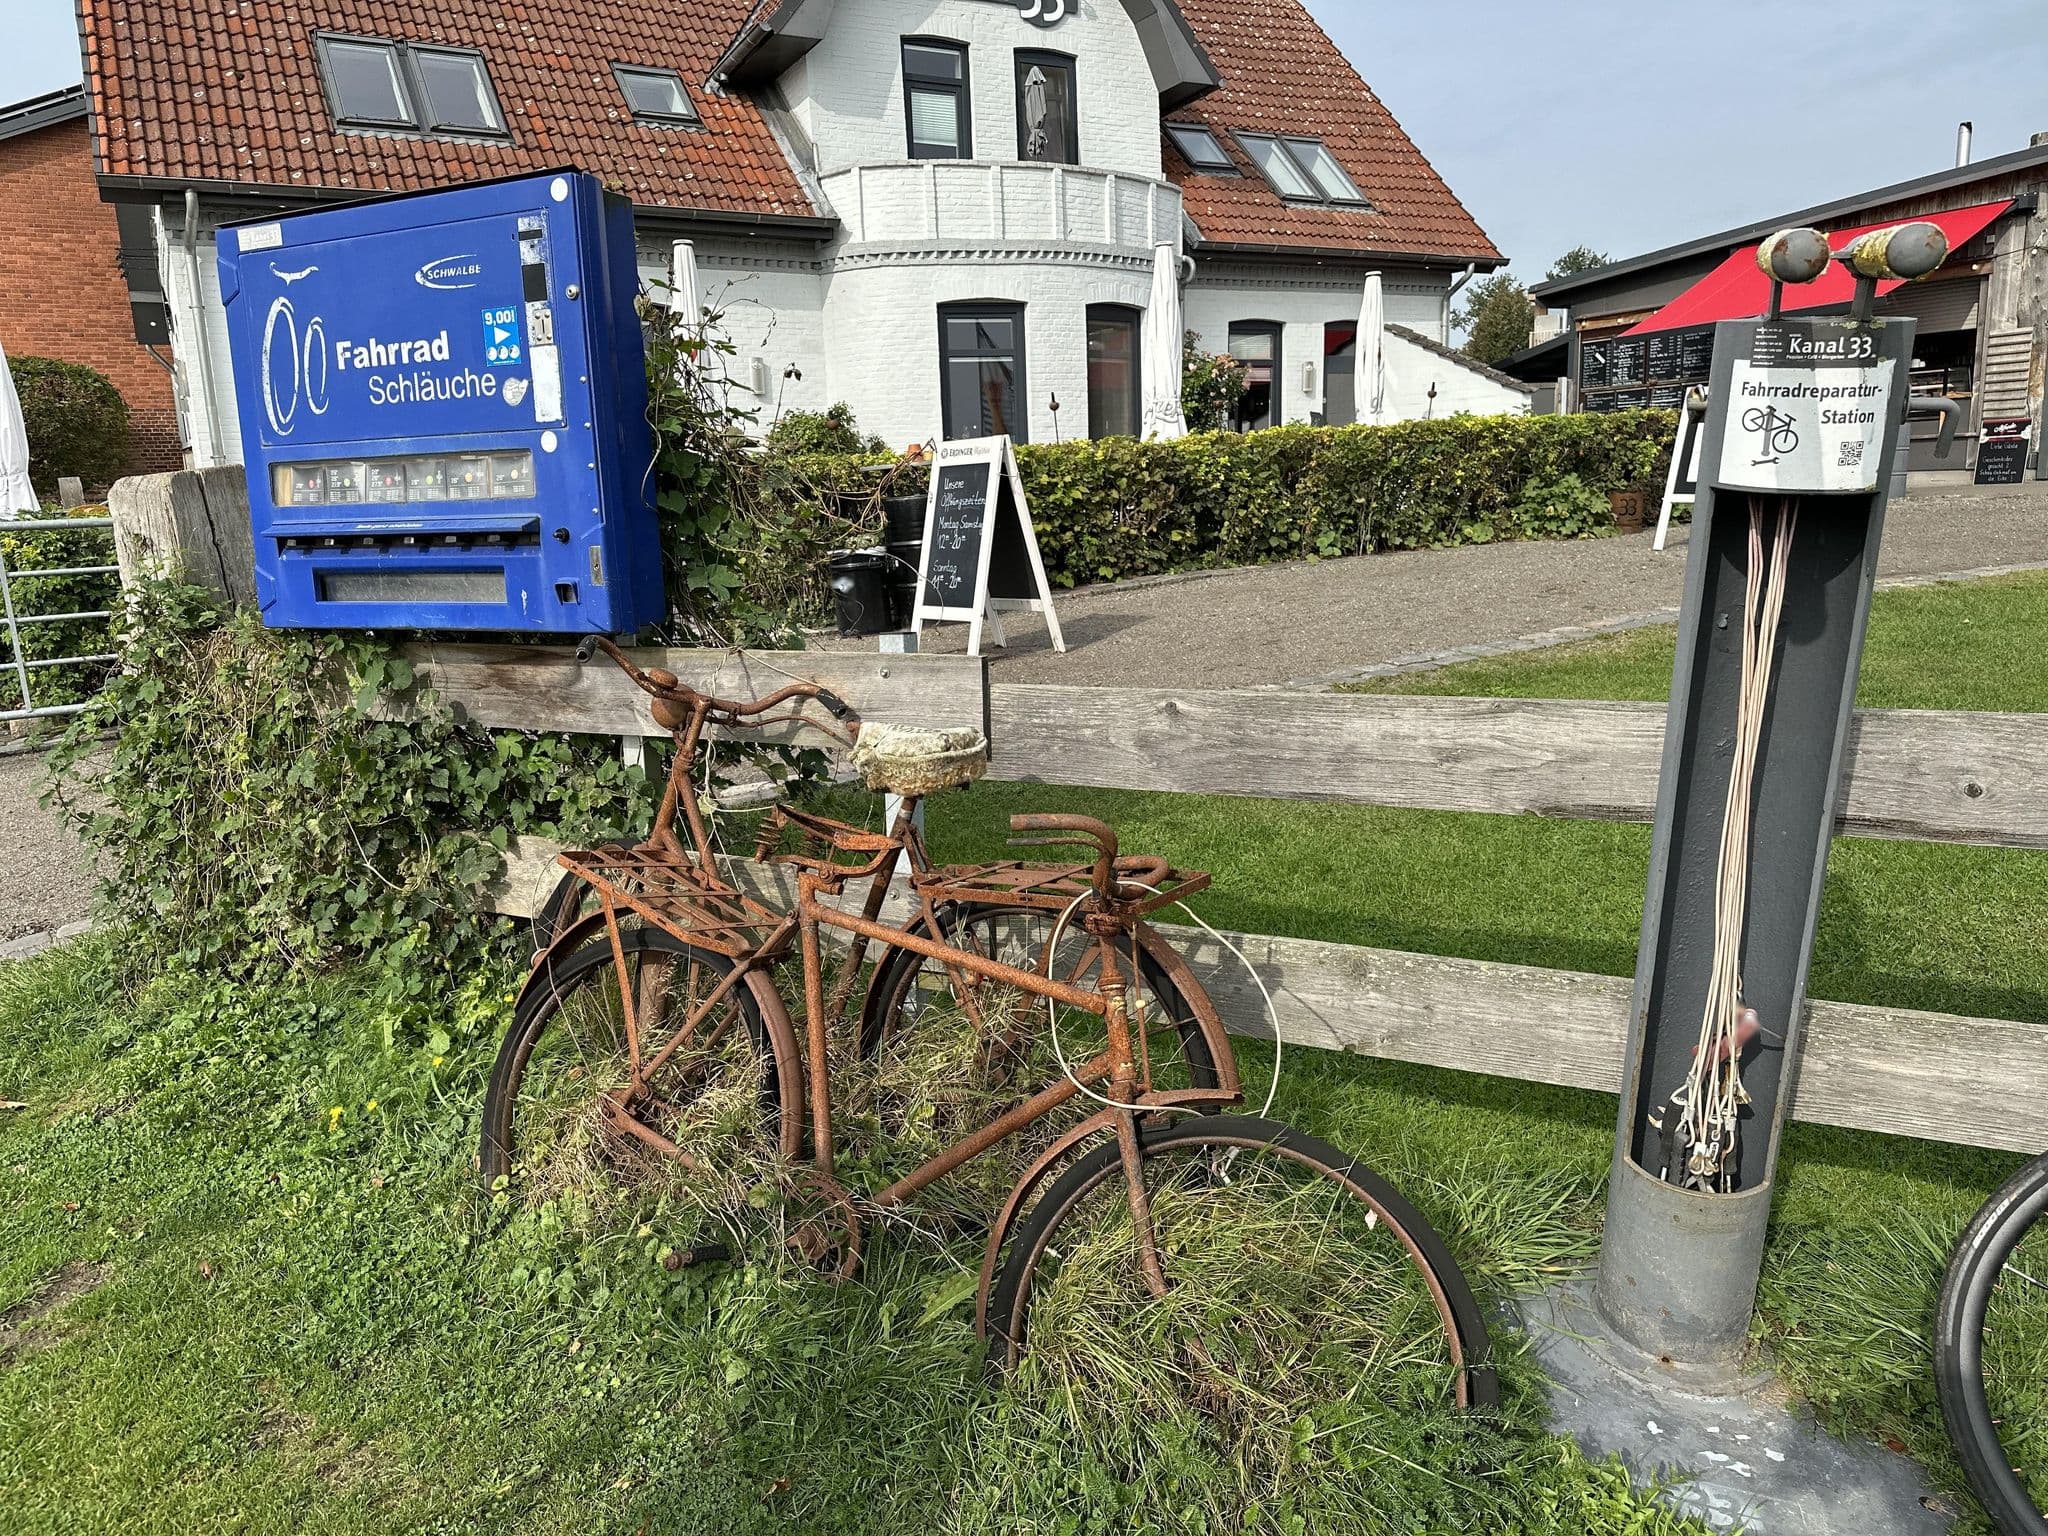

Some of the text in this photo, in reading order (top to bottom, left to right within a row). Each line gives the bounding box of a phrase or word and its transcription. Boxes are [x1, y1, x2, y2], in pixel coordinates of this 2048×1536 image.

[427, 264, 482, 280] SCHWALBE
[335, 330, 450, 370] Fahrrad
[1789, 336, 1845, 353] Kanal
[369, 368, 497, 404] Schläuche
[1741, 382, 1883, 402] Fahrradreparatur-
[1821, 408, 1875, 424] Station
[949, 448, 973, 457] ERDINGER
[944, 477, 965, 490] Unsere
